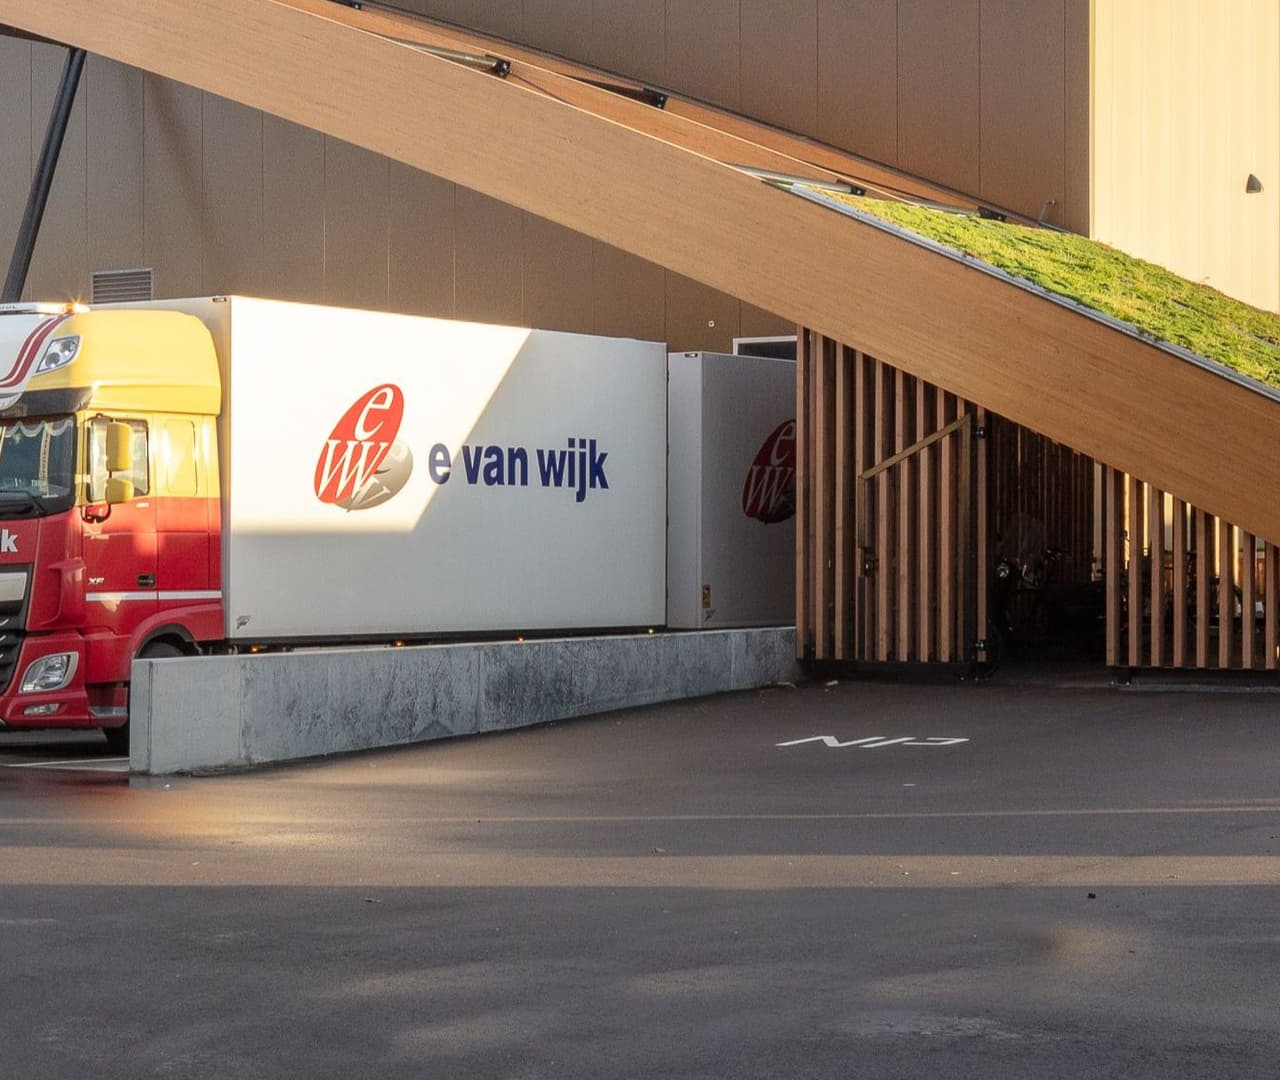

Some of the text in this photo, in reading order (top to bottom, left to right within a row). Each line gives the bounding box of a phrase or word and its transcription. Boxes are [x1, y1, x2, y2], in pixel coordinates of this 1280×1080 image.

[428, 437, 610, 503] e van wijk
[87, 576, 105, 585] XF
